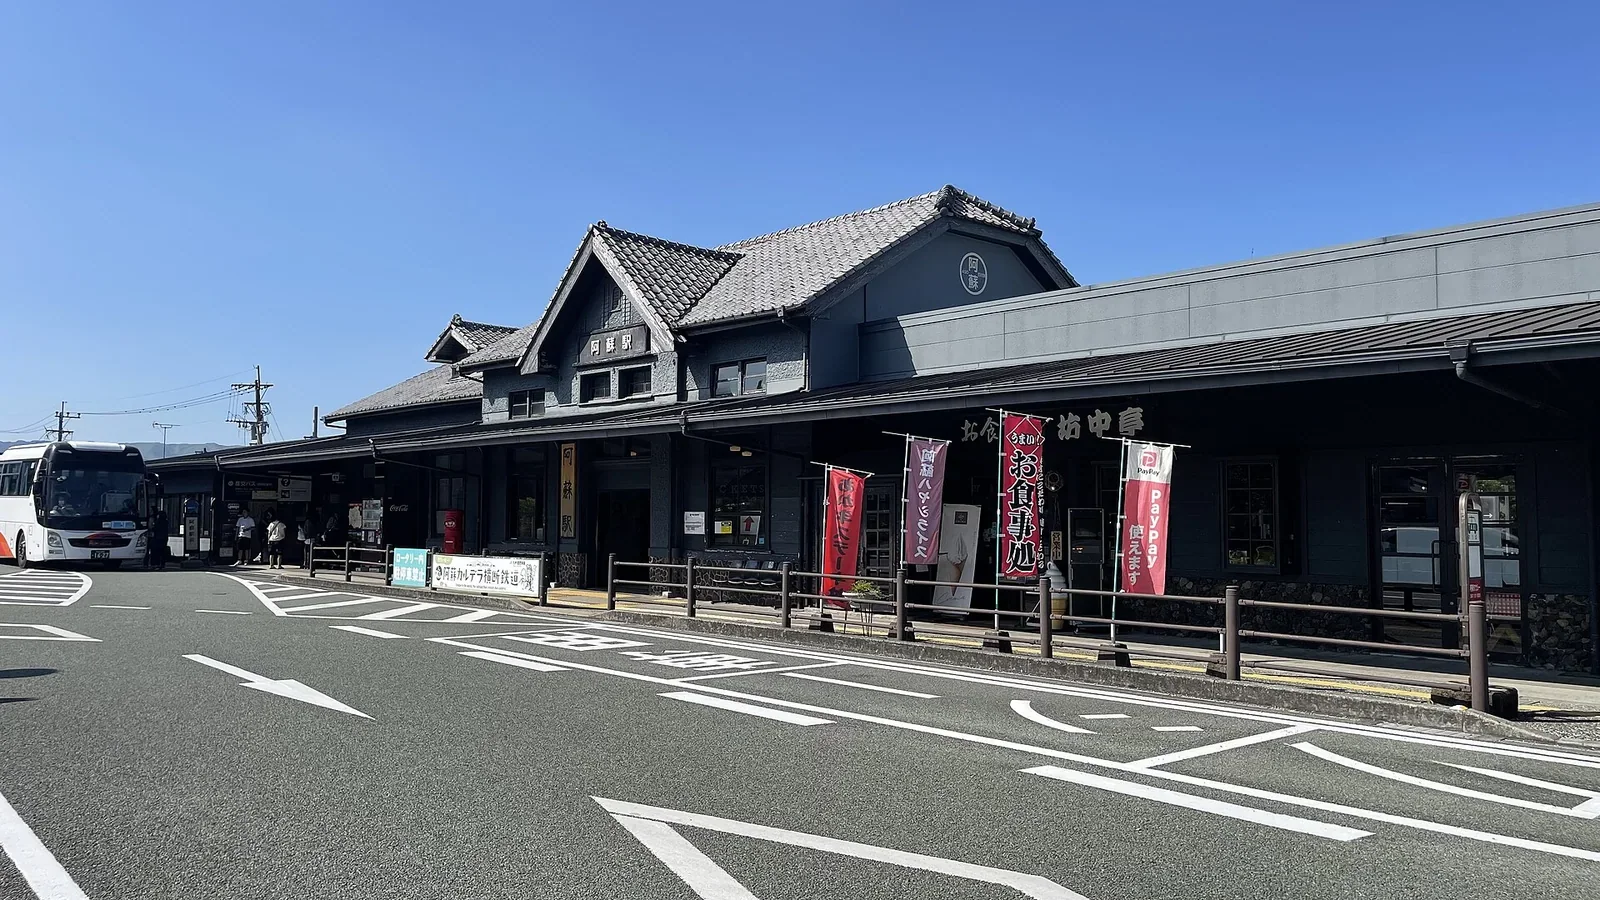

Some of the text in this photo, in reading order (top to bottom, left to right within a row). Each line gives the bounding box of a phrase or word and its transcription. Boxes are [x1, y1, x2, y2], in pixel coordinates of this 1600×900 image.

[968, 256, 979, 290] 阿蘇
[590, 334, 633, 356] 阿蘇駅
[1057, 406, 1145, 441] 坊中亭
[1137, 467, 1159, 478] PayPay
[561, 447, 574, 533] 阿蘇駅
[914, 448, 936, 558] 阿蘇ハヤシライス
[389, 504, 409, 512] Coca-Cola
[1006, 449, 1038, 574] お食事処
[1147, 490, 1162, 569] PayPay
[395, 552, 424, 566] ロータリー内
[1129, 524, 1144, 586] 使えます
[394, 566, 425, 582] 駐停車禁止
[443, 566, 519, 586] 阿蘇カルデラ横断鉄道
